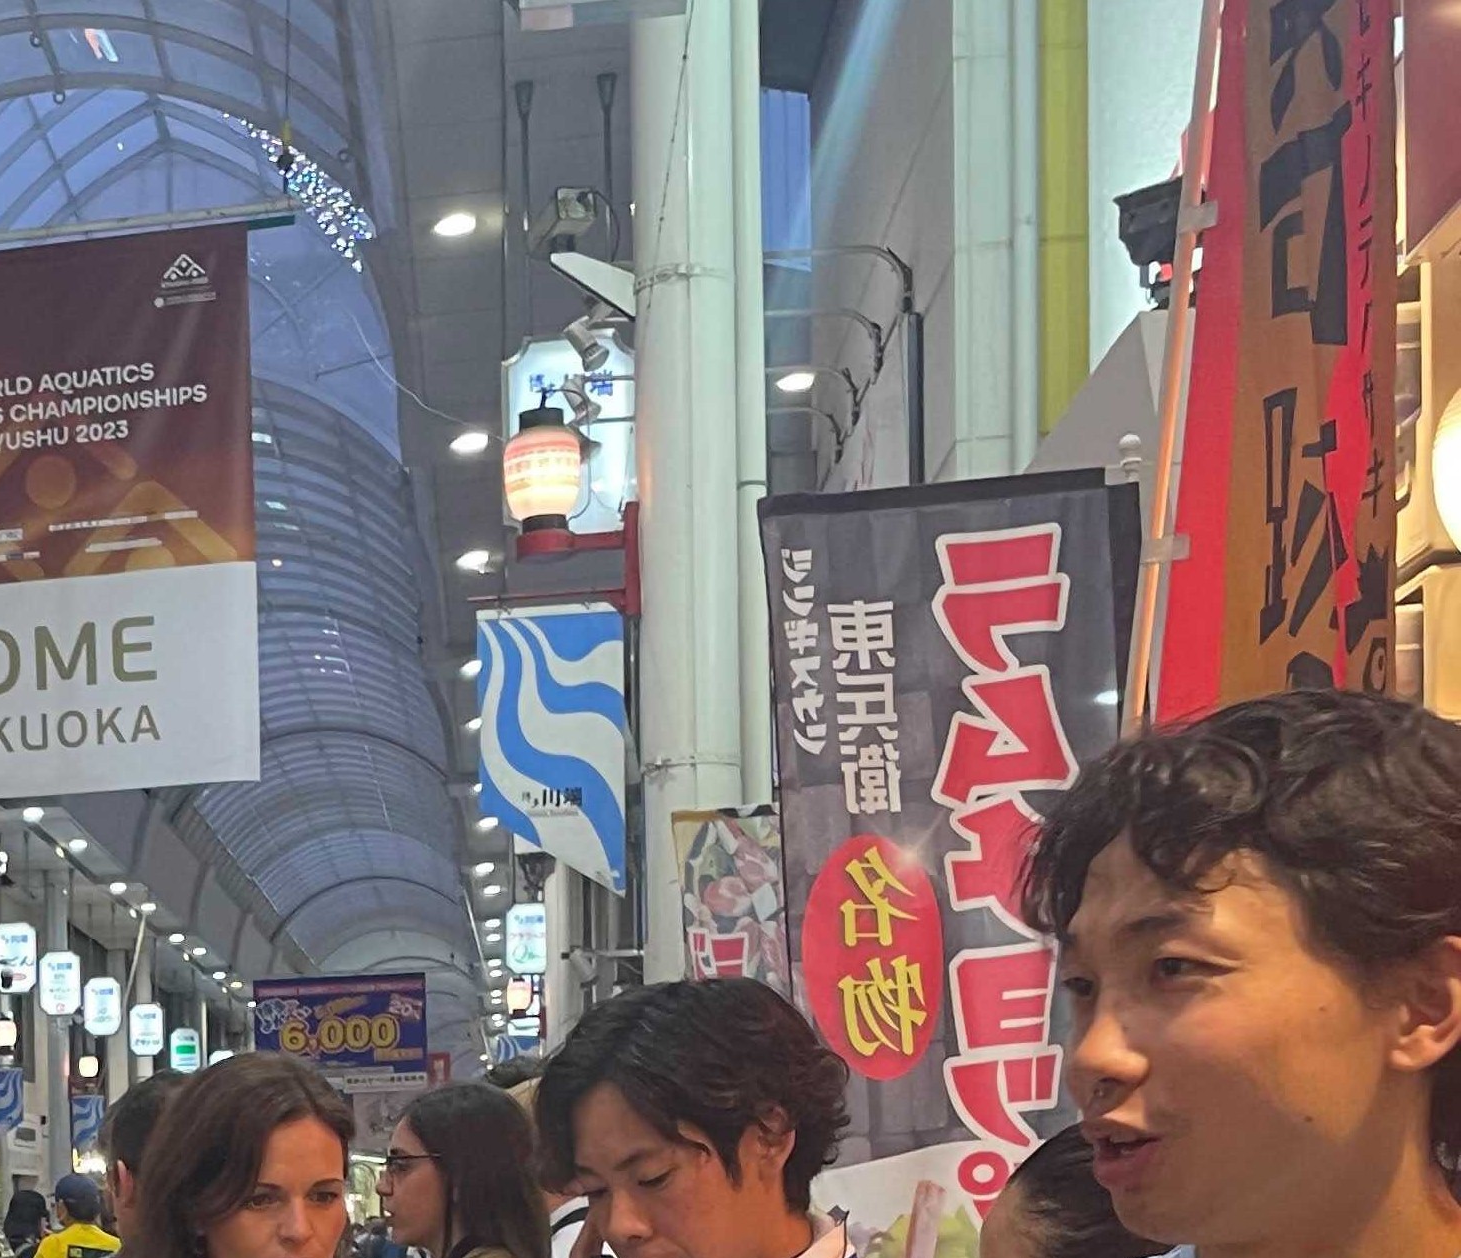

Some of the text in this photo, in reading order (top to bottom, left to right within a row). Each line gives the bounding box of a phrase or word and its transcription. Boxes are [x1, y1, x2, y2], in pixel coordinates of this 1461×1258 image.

[39, 362, 154, 394] AQUATICS
[10, 384, 207, 423] CHAMPIONSHIPS
[76, 420, 129, 443] 2023
[280, 1013, 400, 1053] 6,000
